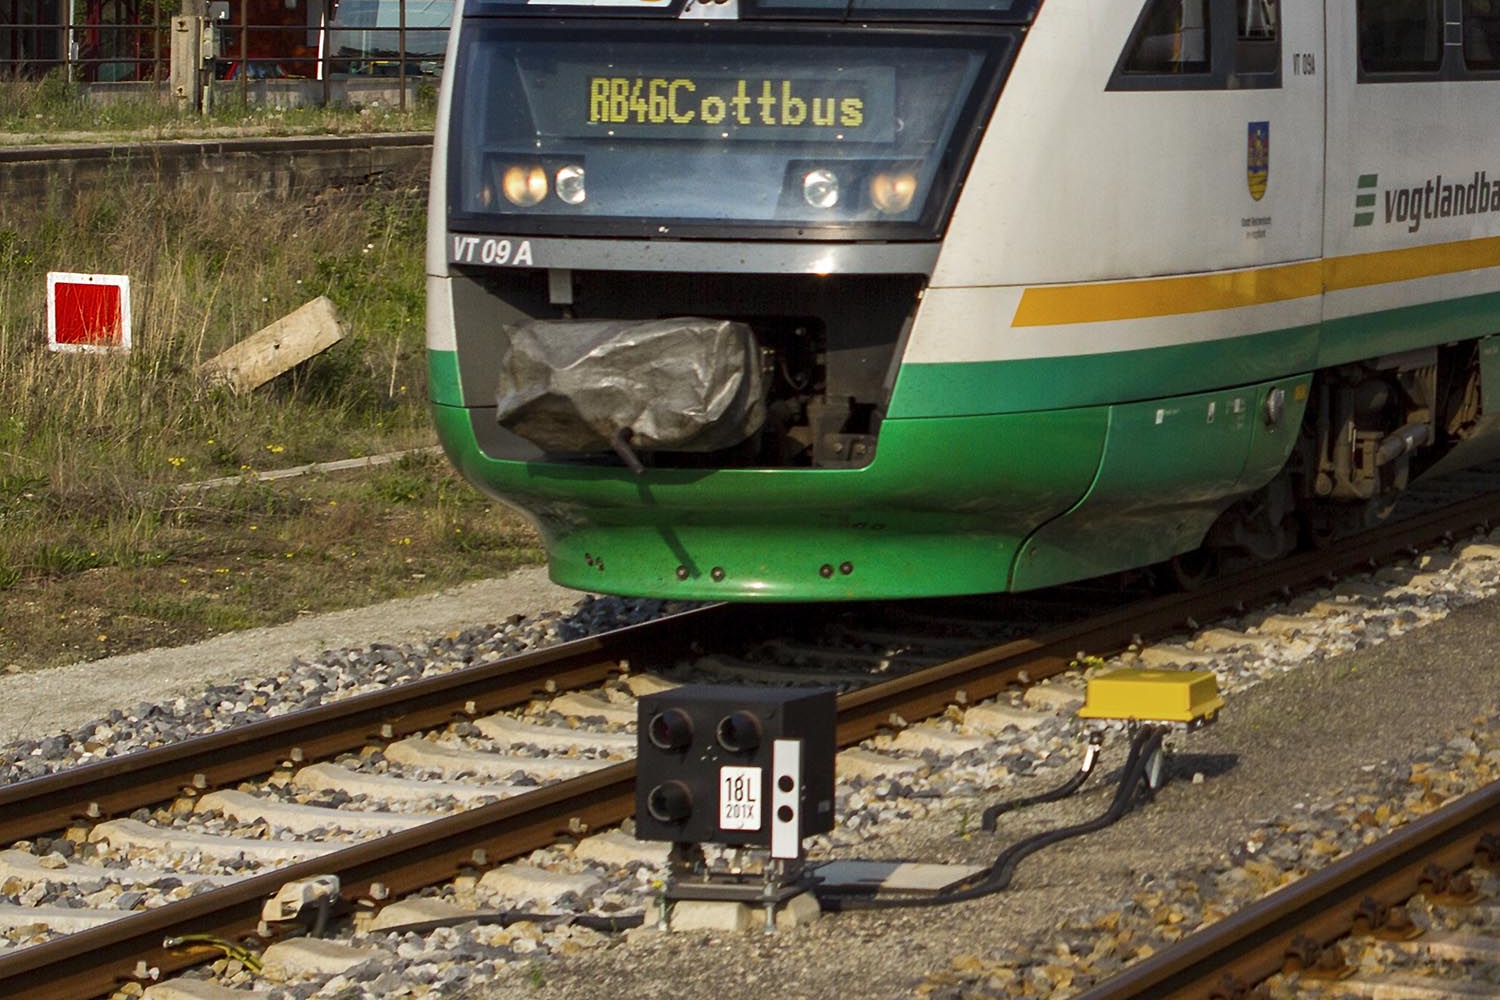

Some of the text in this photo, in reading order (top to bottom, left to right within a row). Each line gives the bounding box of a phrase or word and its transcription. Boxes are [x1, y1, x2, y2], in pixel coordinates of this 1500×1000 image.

[453, 236, 533, 265] VT 09 A
[725, 774, 756, 802] 18L
